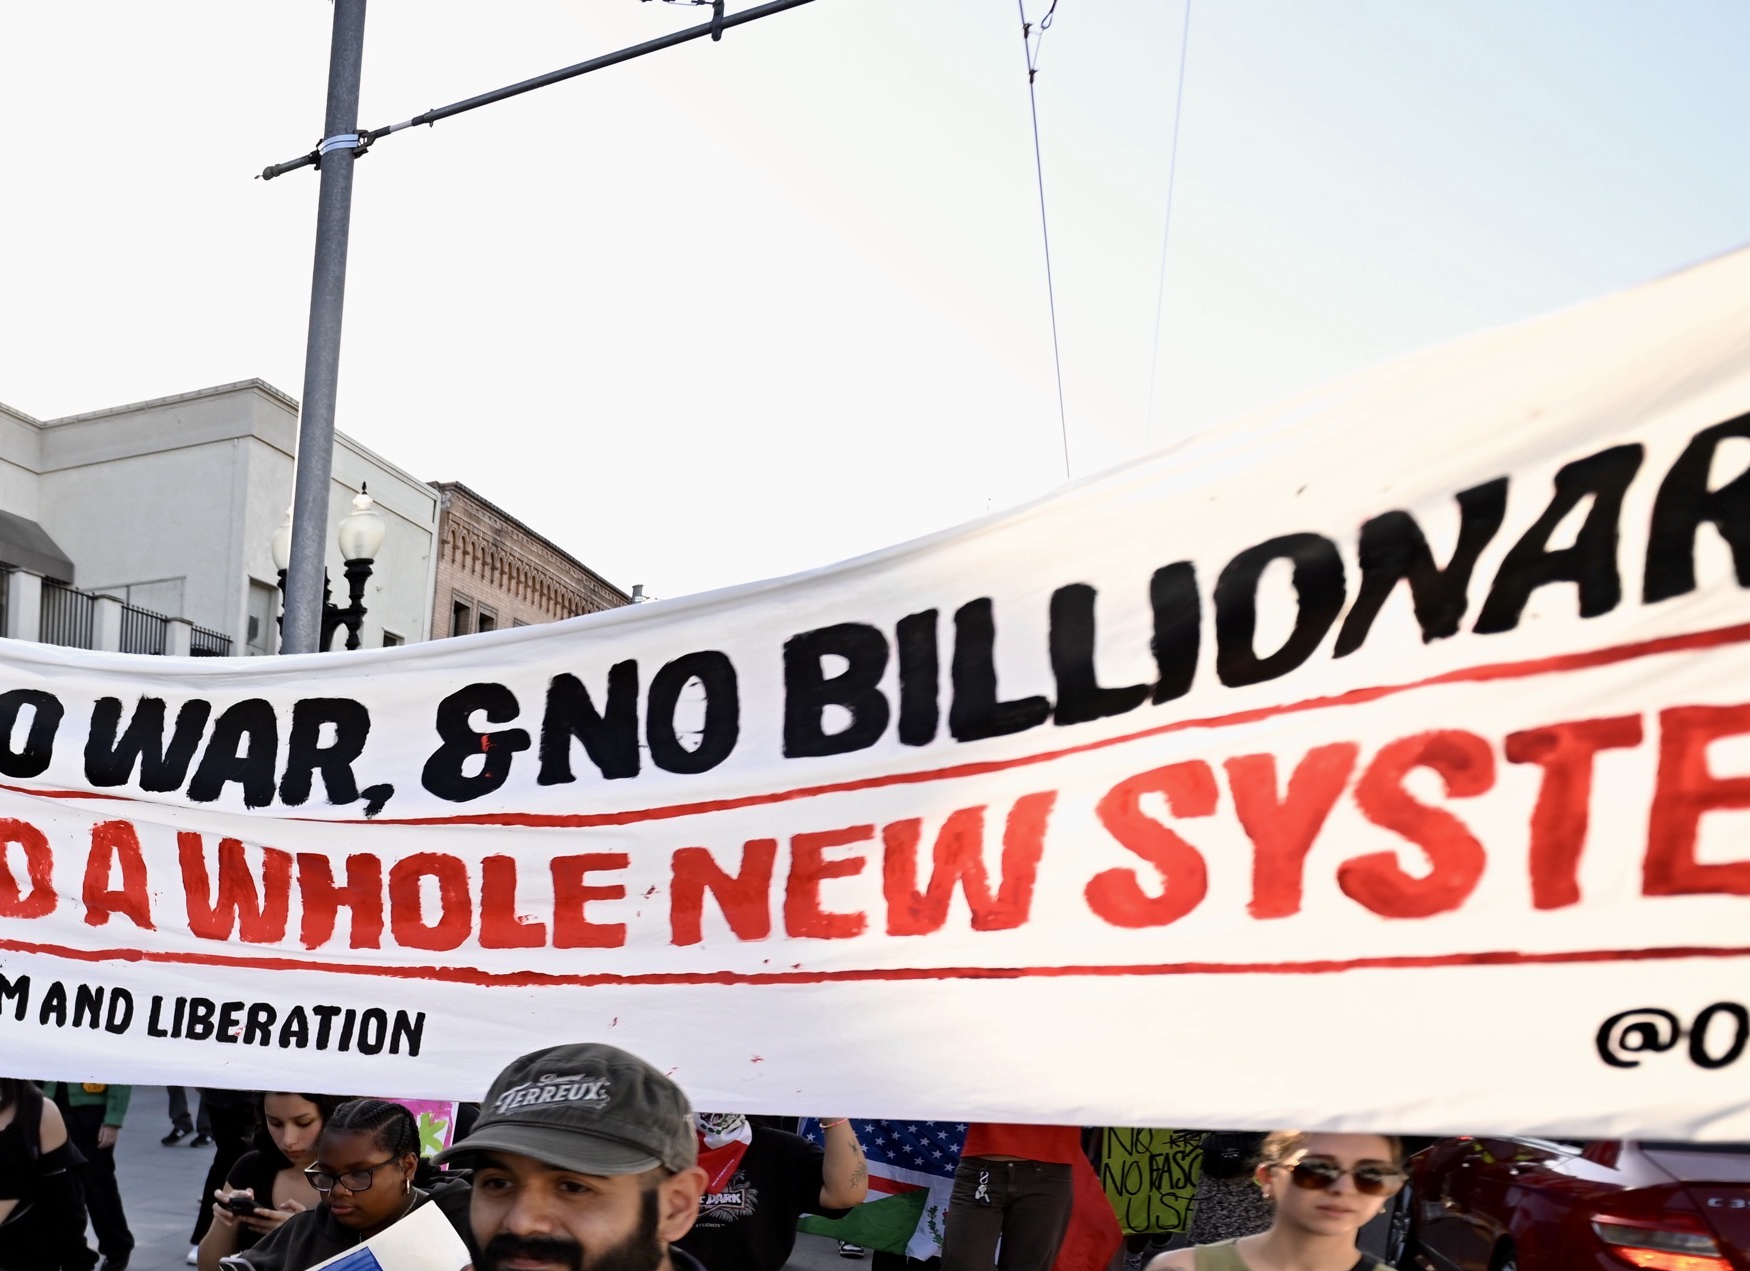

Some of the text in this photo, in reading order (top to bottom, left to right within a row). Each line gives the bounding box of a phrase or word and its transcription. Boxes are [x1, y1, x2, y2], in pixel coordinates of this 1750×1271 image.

[83, 694, 395, 819] WAR,
[782, 410, 1750, 759] BILLIONAR
[82, 819, 157, 931] A
[176, 830, 630, 952] WHOLE
[669, 789, 1059, 947] NEW
[1083, 702, 1750, 930] SYSTE
[39, 982, 134, 1036] AND
[147, 995, 427, 1058] LIBERATION
[1103, 1160, 1143, 1197] NO
